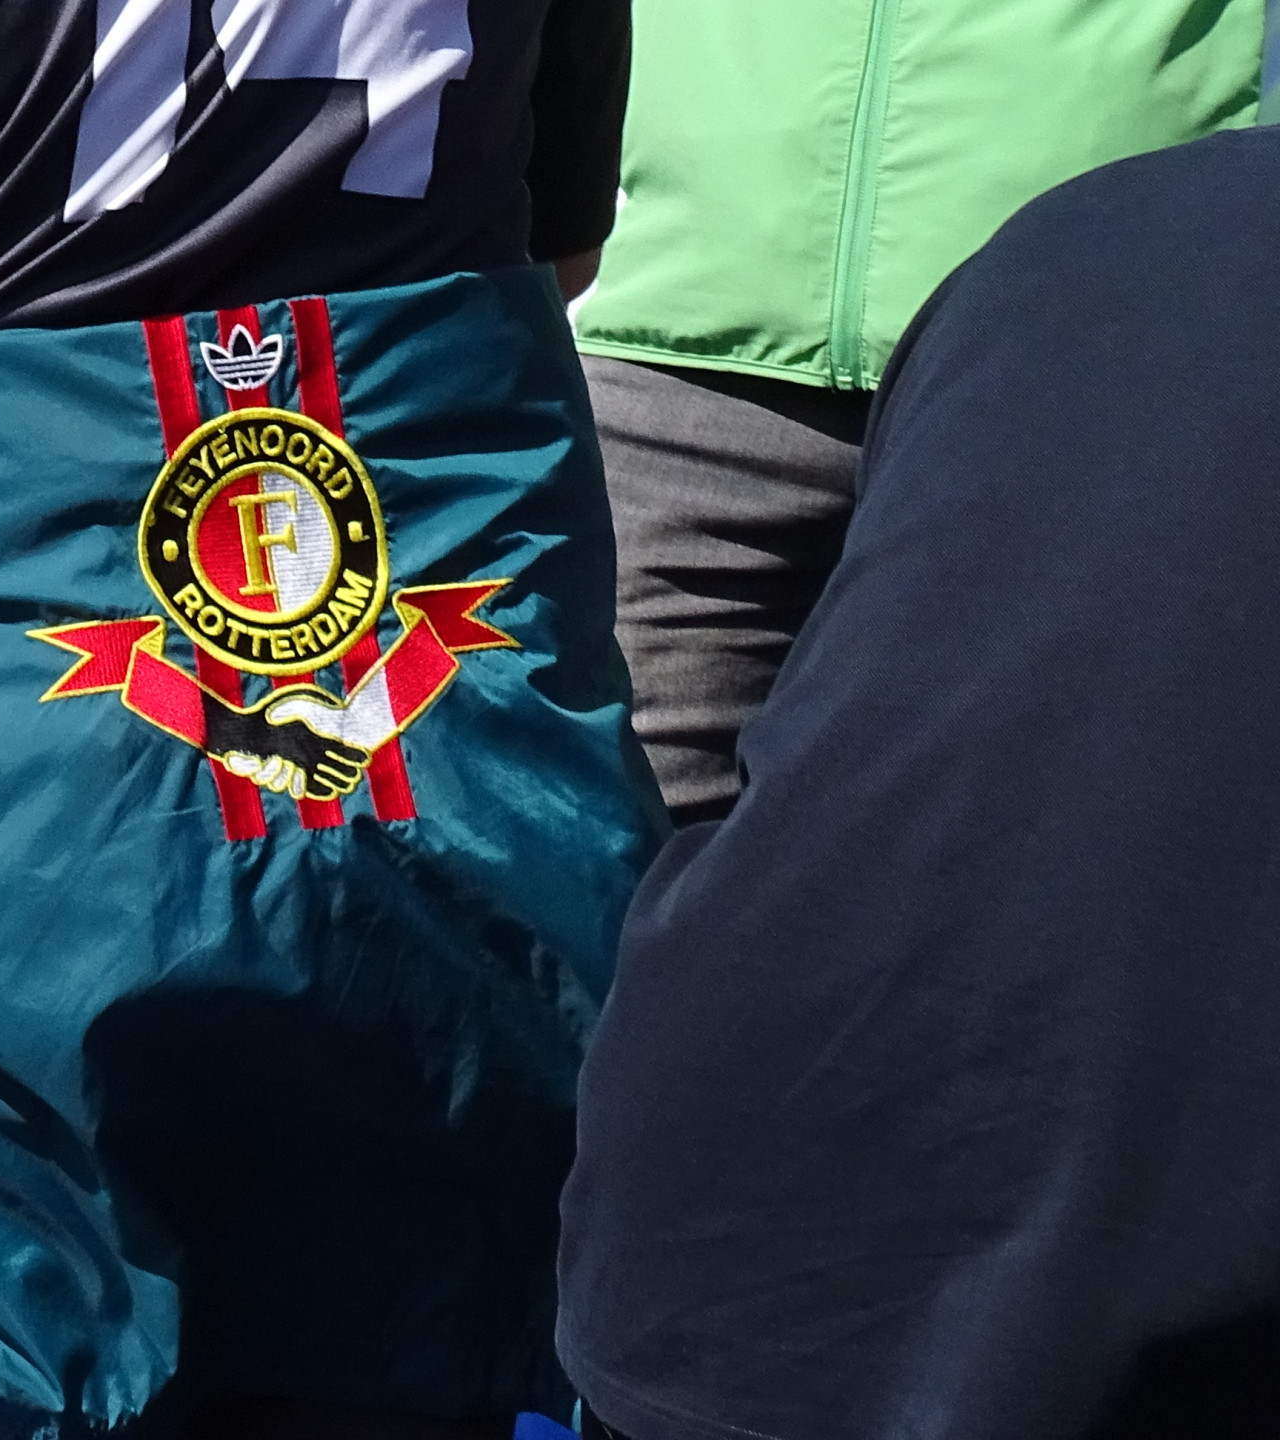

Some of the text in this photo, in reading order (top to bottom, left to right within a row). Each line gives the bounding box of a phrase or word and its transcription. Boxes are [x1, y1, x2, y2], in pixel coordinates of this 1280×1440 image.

[162, 423, 353, 519] FEYENOORD
[229, 490, 299, 596] F
[172, 567, 373, 661] ROTTERDAM
